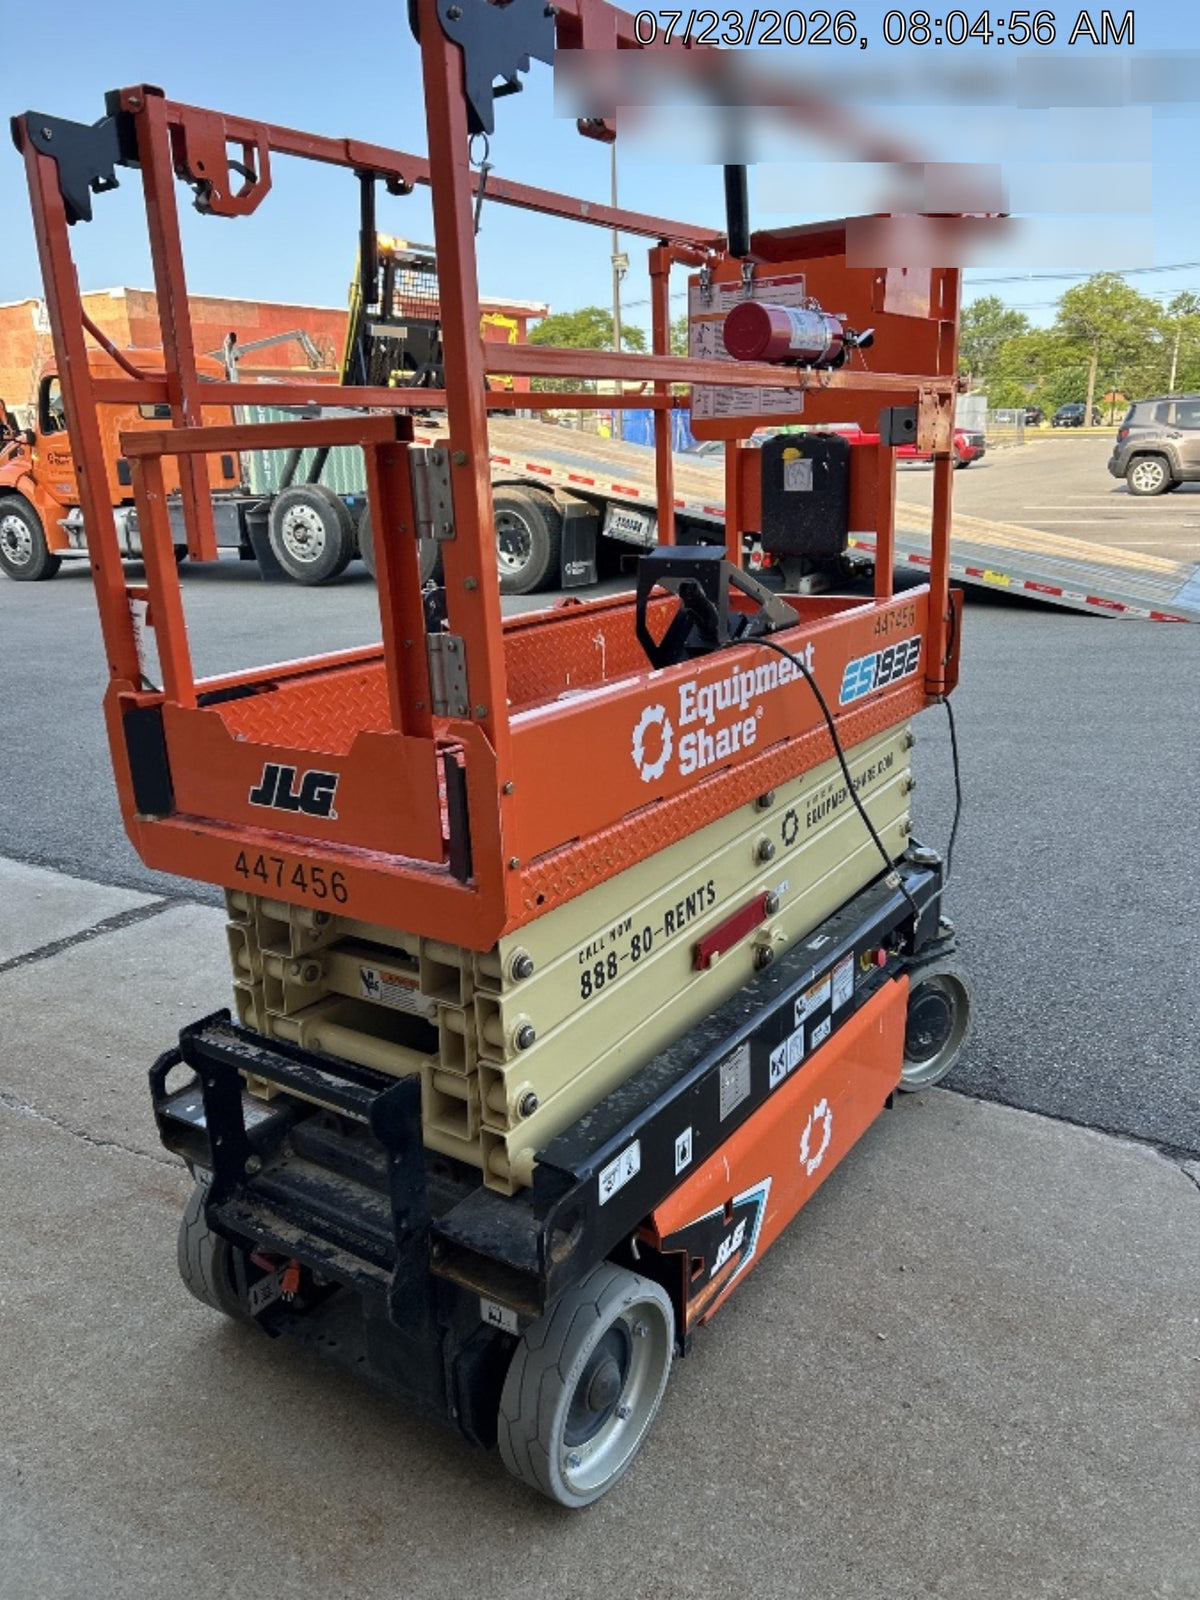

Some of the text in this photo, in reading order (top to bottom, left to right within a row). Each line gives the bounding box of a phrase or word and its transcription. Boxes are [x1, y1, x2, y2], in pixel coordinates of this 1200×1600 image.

[678, 641, 815, 726] Equipment
[839, 634, 922, 706] ES1932
[249, 762, 340, 820] JLG
[234, 850, 348, 904] 447456
[578, 917, 632, 965] CALL NOW
[580, 880, 716, 1000] 888-80-RENTS
